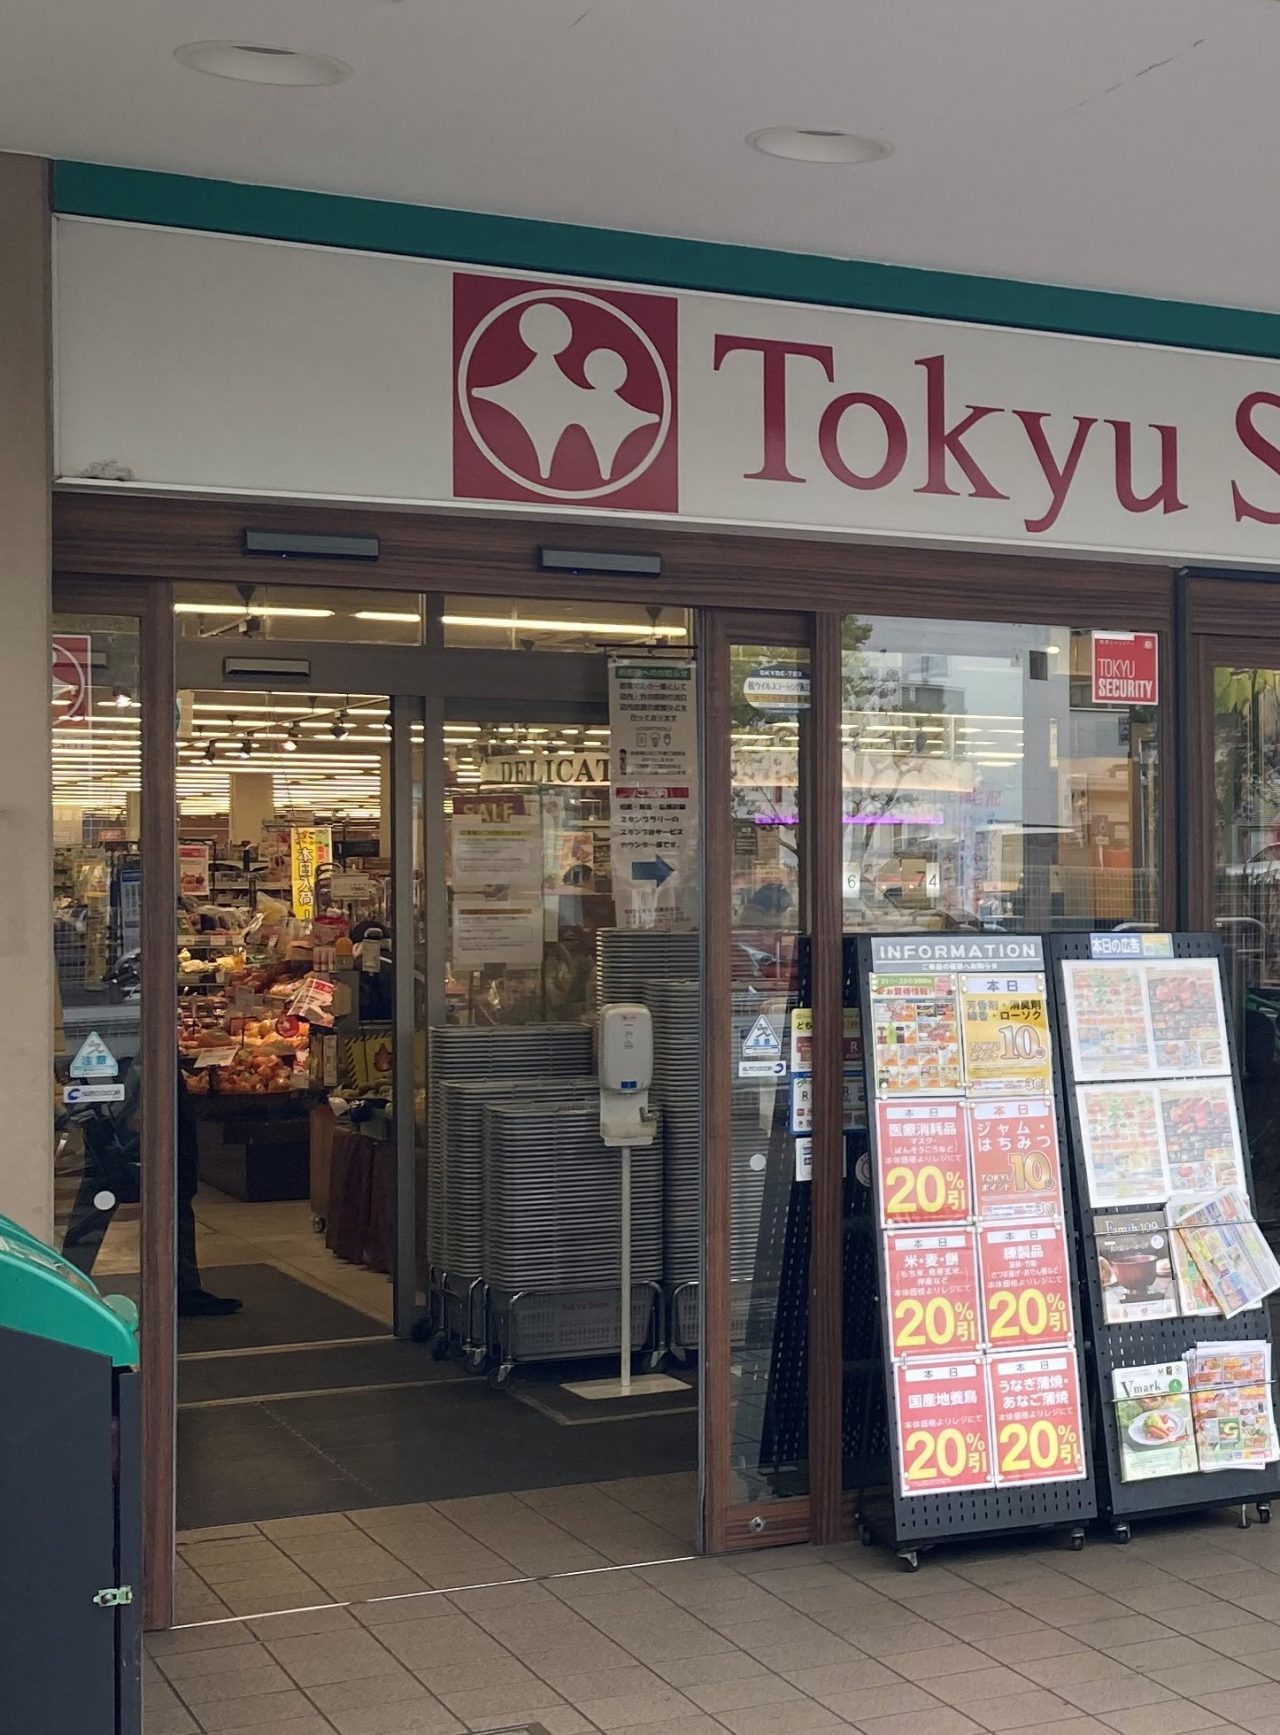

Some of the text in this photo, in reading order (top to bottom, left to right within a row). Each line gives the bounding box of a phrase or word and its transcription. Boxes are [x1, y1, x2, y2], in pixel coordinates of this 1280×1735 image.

[714, 333, 1188, 533] Tokyu
[1098, 658, 1136, 679] TOKYU
[1098, 678, 1153, 699] SECURITY
[463, 803, 514, 824] SALE
[847, 874, 856, 889] 6
[928, 873, 938, 887] 4
[879, 943, 1036, 960] INFORMATION
[1092, 937, 1140, 954] 本日の広告
[987, 979, 1018, 993] 本日
[904, 1108, 939, 1118] 本日
[993, 1104, 1029, 1116] 本日
[889, 1121, 957, 1137] 医療消耗品
[976, 1120, 1047, 1136] ジャム・
[978, 1135, 1051, 1152] はちみつ
[885, 1154, 963, 1165] 本体価格よりレジにて
[981, 1173, 1013, 1182] TOKYU
[981, 1182, 1011, 1192] ポイント
[1005, 1230, 1038, 1241] 本日
[913, 1239, 947, 1248] 本日
[904, 1252, 959, 1268] 米・麦・餅
[987, 1276, 1063, 1289] 本体価格よりレジにて
[894, 1284, 971, 1297] 本体価格よりレジにて
[924, 1367, 958, 1379] 本日
[1016, 1360, 1049, 1372] 本日
[1120, 1379, 1162, 1398] Vmark
[1003, 1391, 1069, 1409] あなご蒲焼
[999, 1406, 1074, 1421] 本体価格よりレジにて
[905, 1414, 984, 1429] 本体価格よりレジにて
